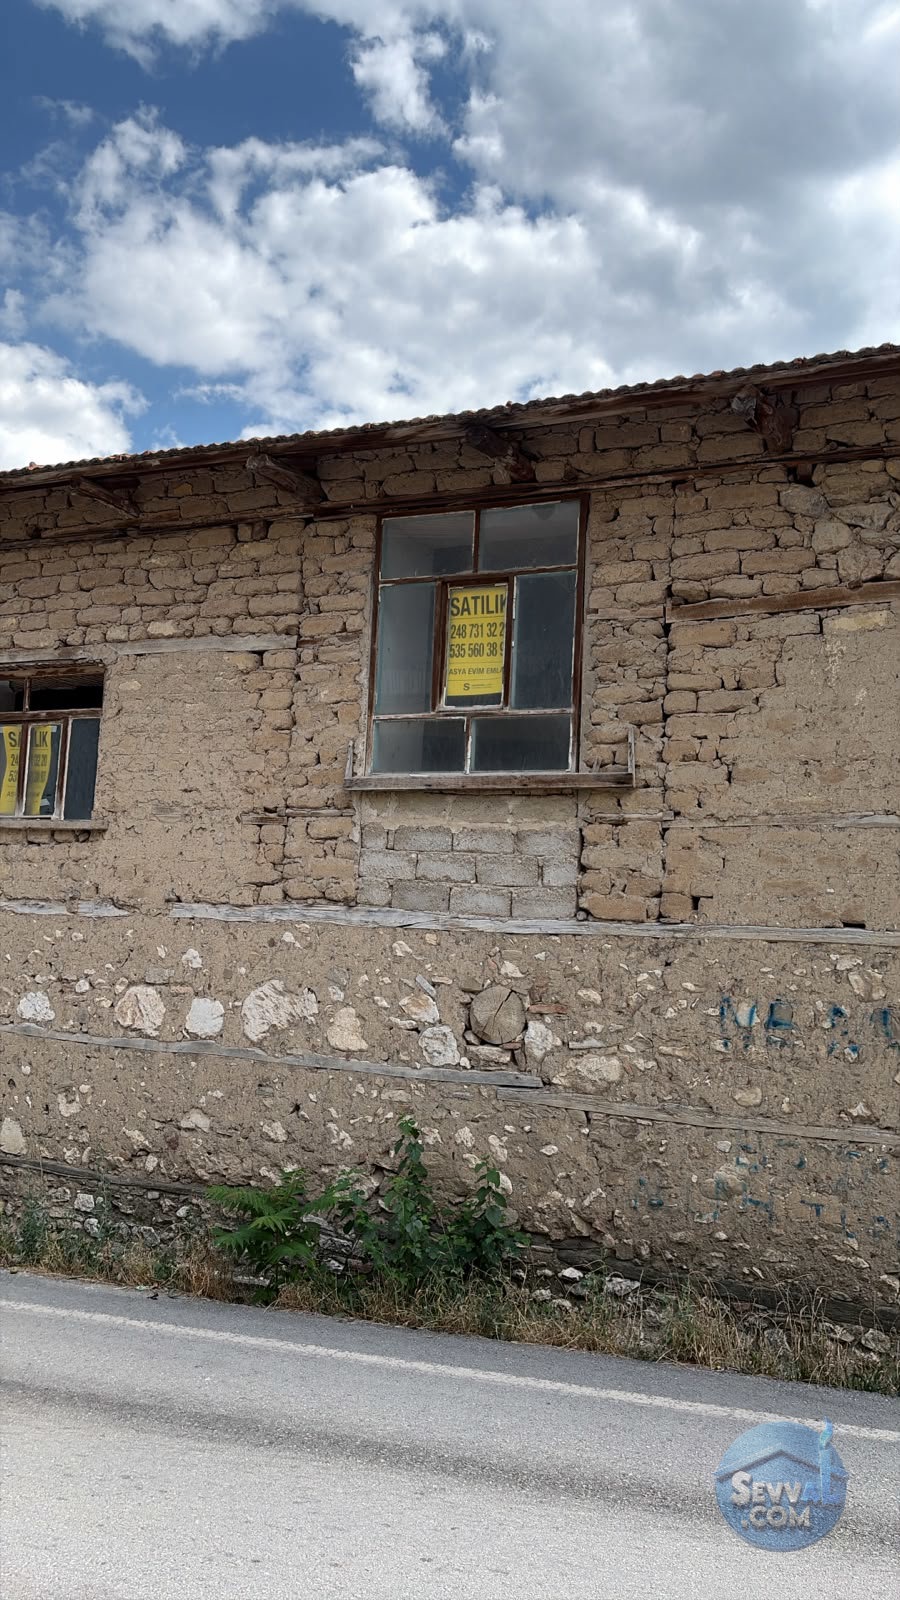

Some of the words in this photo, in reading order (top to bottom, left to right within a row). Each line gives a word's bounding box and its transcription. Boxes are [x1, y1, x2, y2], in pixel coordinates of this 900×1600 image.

[450, 594, 506, 617] SATILIK
[450, 624, 467, 639] 248
[469, 623, 484, 638] 731
[486, 622, 497, 637] 32
[450, 643, 466, 658] 535
[468, 643, 484, 657] 560
[486, 642, 497, 657] 38
